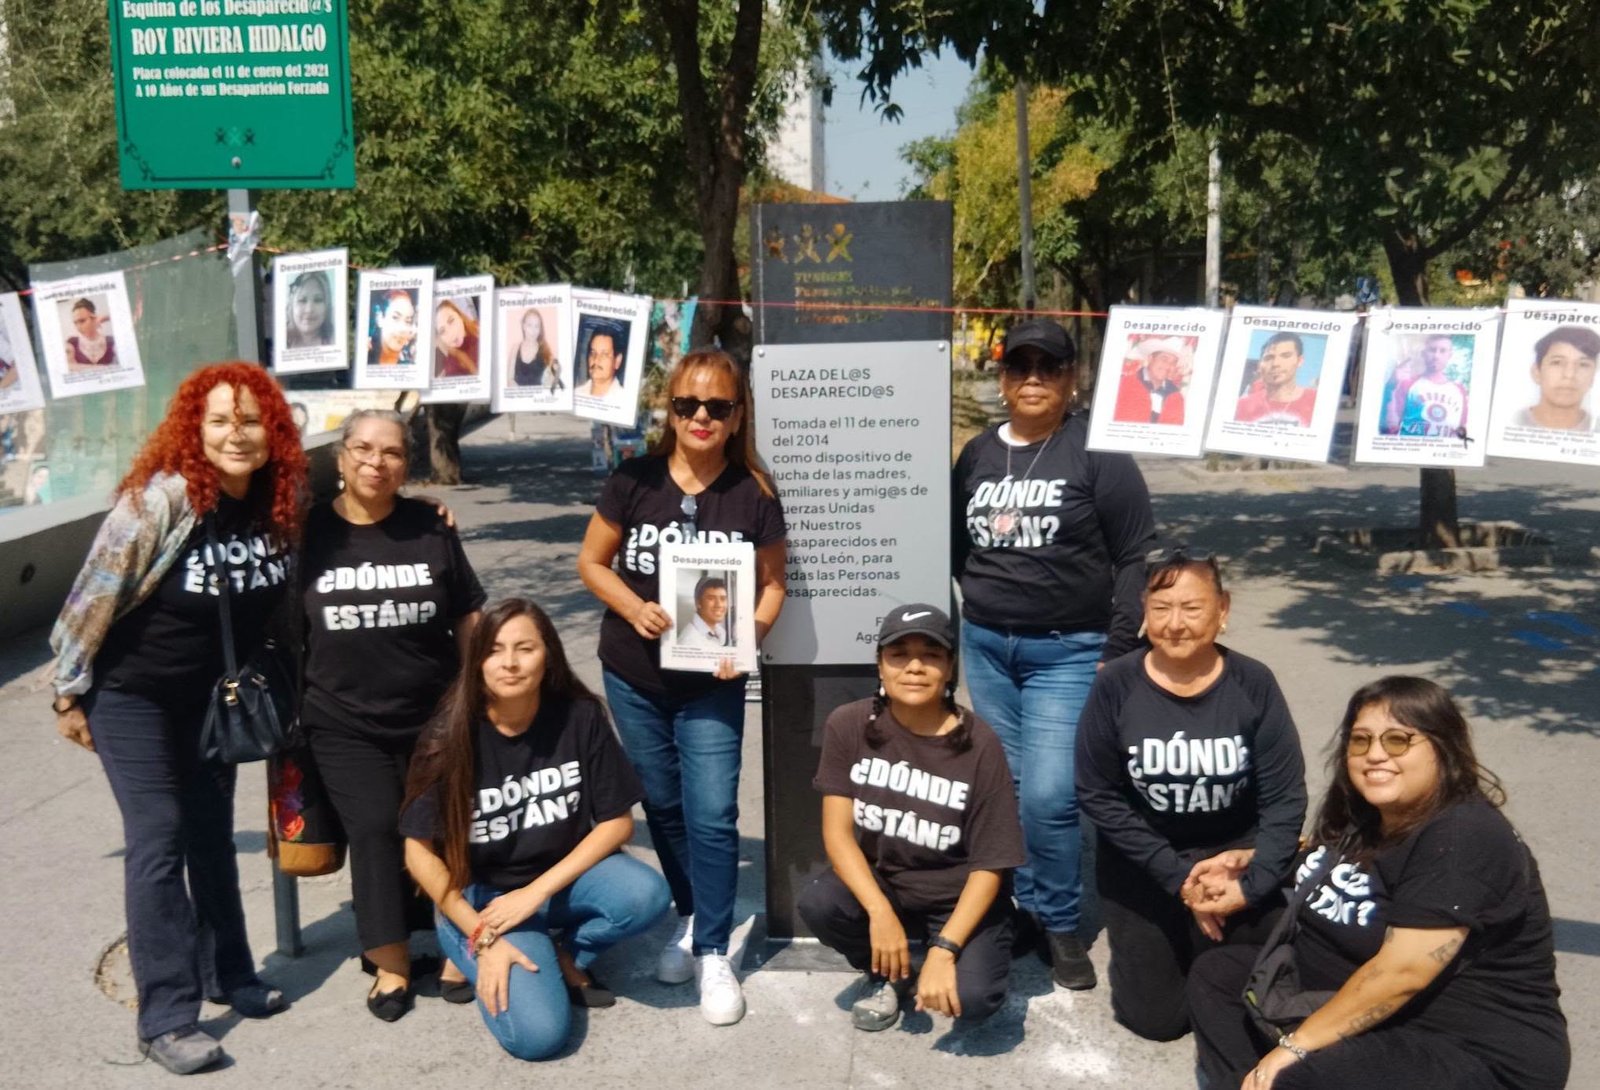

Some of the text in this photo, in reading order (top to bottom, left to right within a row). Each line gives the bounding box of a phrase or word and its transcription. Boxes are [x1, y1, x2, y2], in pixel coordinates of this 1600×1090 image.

[123, 1, 176, 19] Esquina
[179, 0, 197, 16] de
[201, 0, 220, 16] los
[131, 24, 327, 55] ROY RIVIERA HIDALGO
[133, 63, 329, 80] Placa colocada el 11 de enero del 2021
[135, 81, 329, 97] A 10 Años de sus Desaparición Forzada
[280, 258, 343, 273] Desaparecida
[369, 278, 423, 289] Desaparecida
[500, 295, 563, 307] Desaparecida
[1523, 310, 1600, 324] Desaparec
[1124, 320, 1207, 332] Desaparecido
[1243, 316, 1341, 333] Desaparecido
[771, 368, 871, 381] PLAZA DE L@S
[771, 385, 894, 399] DESAPARECID@S
[772, 416, 920, 430] Tomada el 11 de enero
[772, 434, 829, 447] del 2014
[772, 451, 912, 465] como dispositivo de
[772, 468, 911, 481] lucha de las madres,
[778, 485, 928, 500] amiliares y amig@s de
[782, 503, 875, 515] uerzas Unidas
[784, 520, 862, 531] or Nuestros
[786, 537, 897, 550] esaparecidos en
[672, 555, 742, 566] Desaparecido
[785, 552, 893, 566] uevo León, para
[316, 562, 433, 593] ¿DÓNDE
[784, 569, 900, 581] odas las Personas
[785, 586, 881, 600] esaparecidas.
[323, 599, 437, 630] ESTÁN?
[850, 757, 969, 811] ¿DÓNDE
[469, 790, 581, 843] ESTÁN?
[853, 798, 961, 851] ESTÁN?
